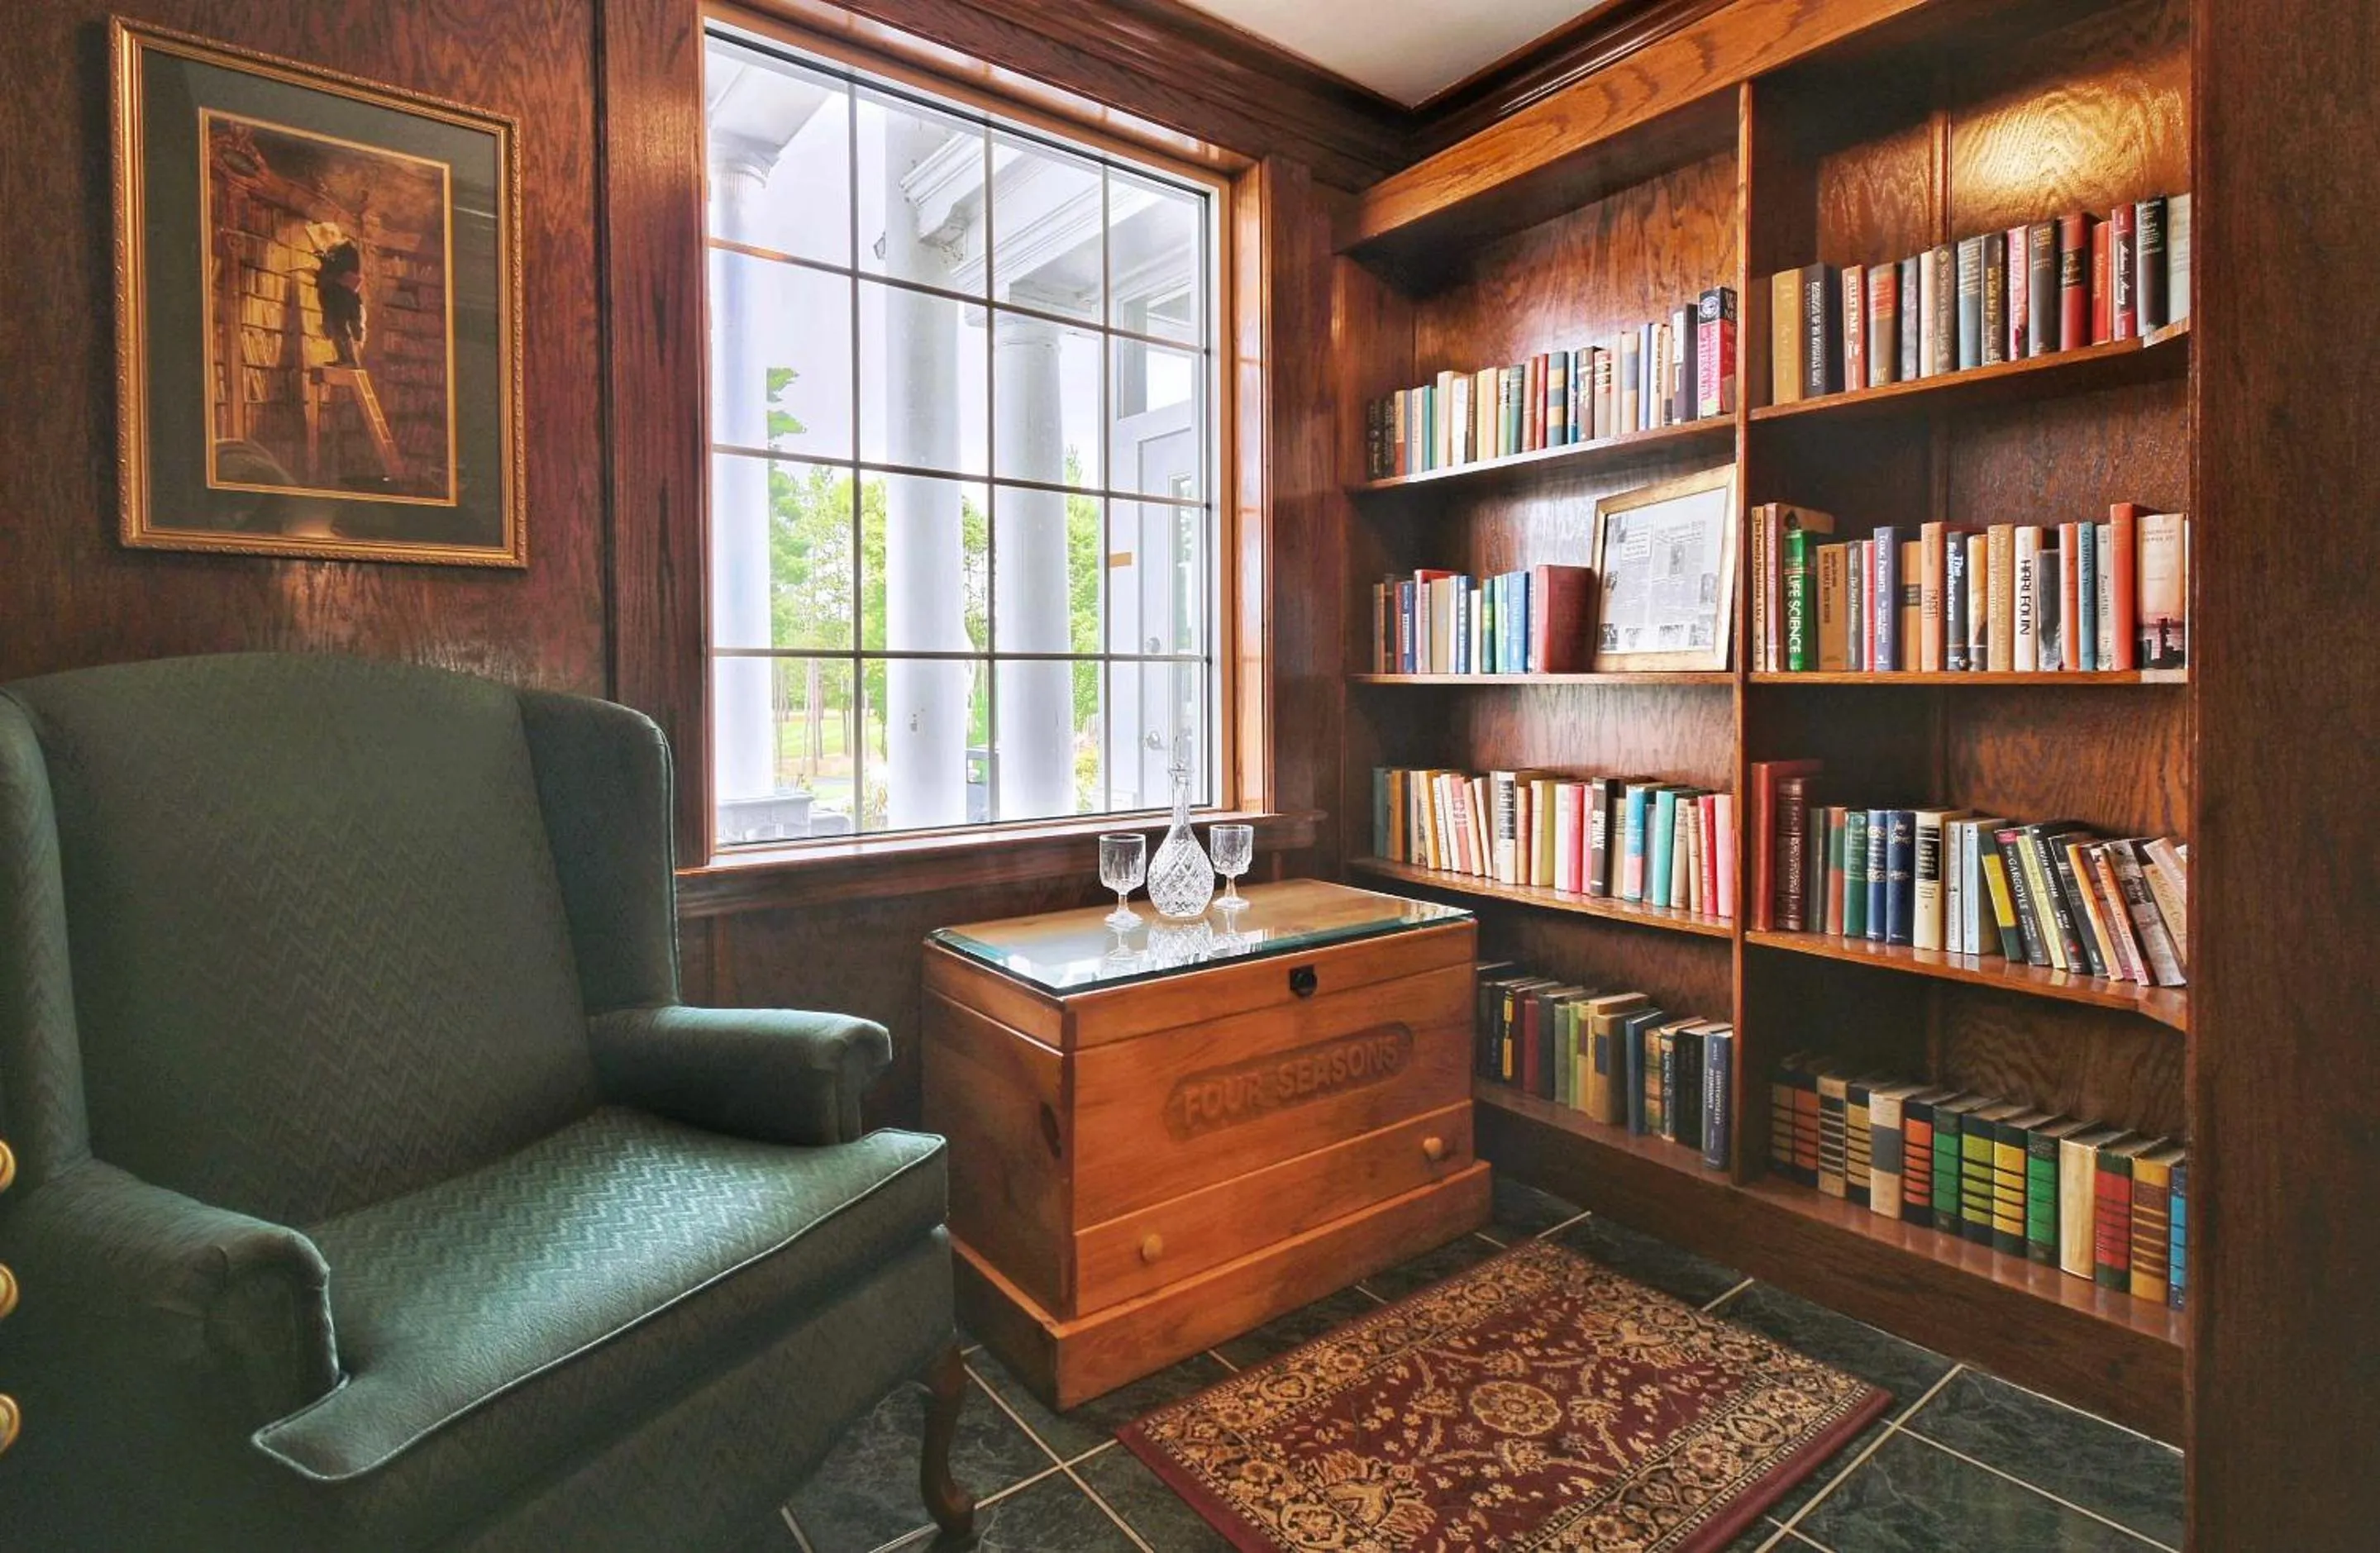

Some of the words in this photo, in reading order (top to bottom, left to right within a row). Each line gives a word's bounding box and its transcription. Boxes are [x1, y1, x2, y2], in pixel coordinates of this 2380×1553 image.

[1787, 575, 1803, 598] LIFE
[2020, 559, 2032, 636] HARLEQUIN
[1787, 600, 1803, 654] SCIENCE
[2007, 858, 2029, 910] GARGOYLE
[1183, 1072, 1266, 1124] FOUR
[1277, 1036, 1400, 1098] SEASONS
